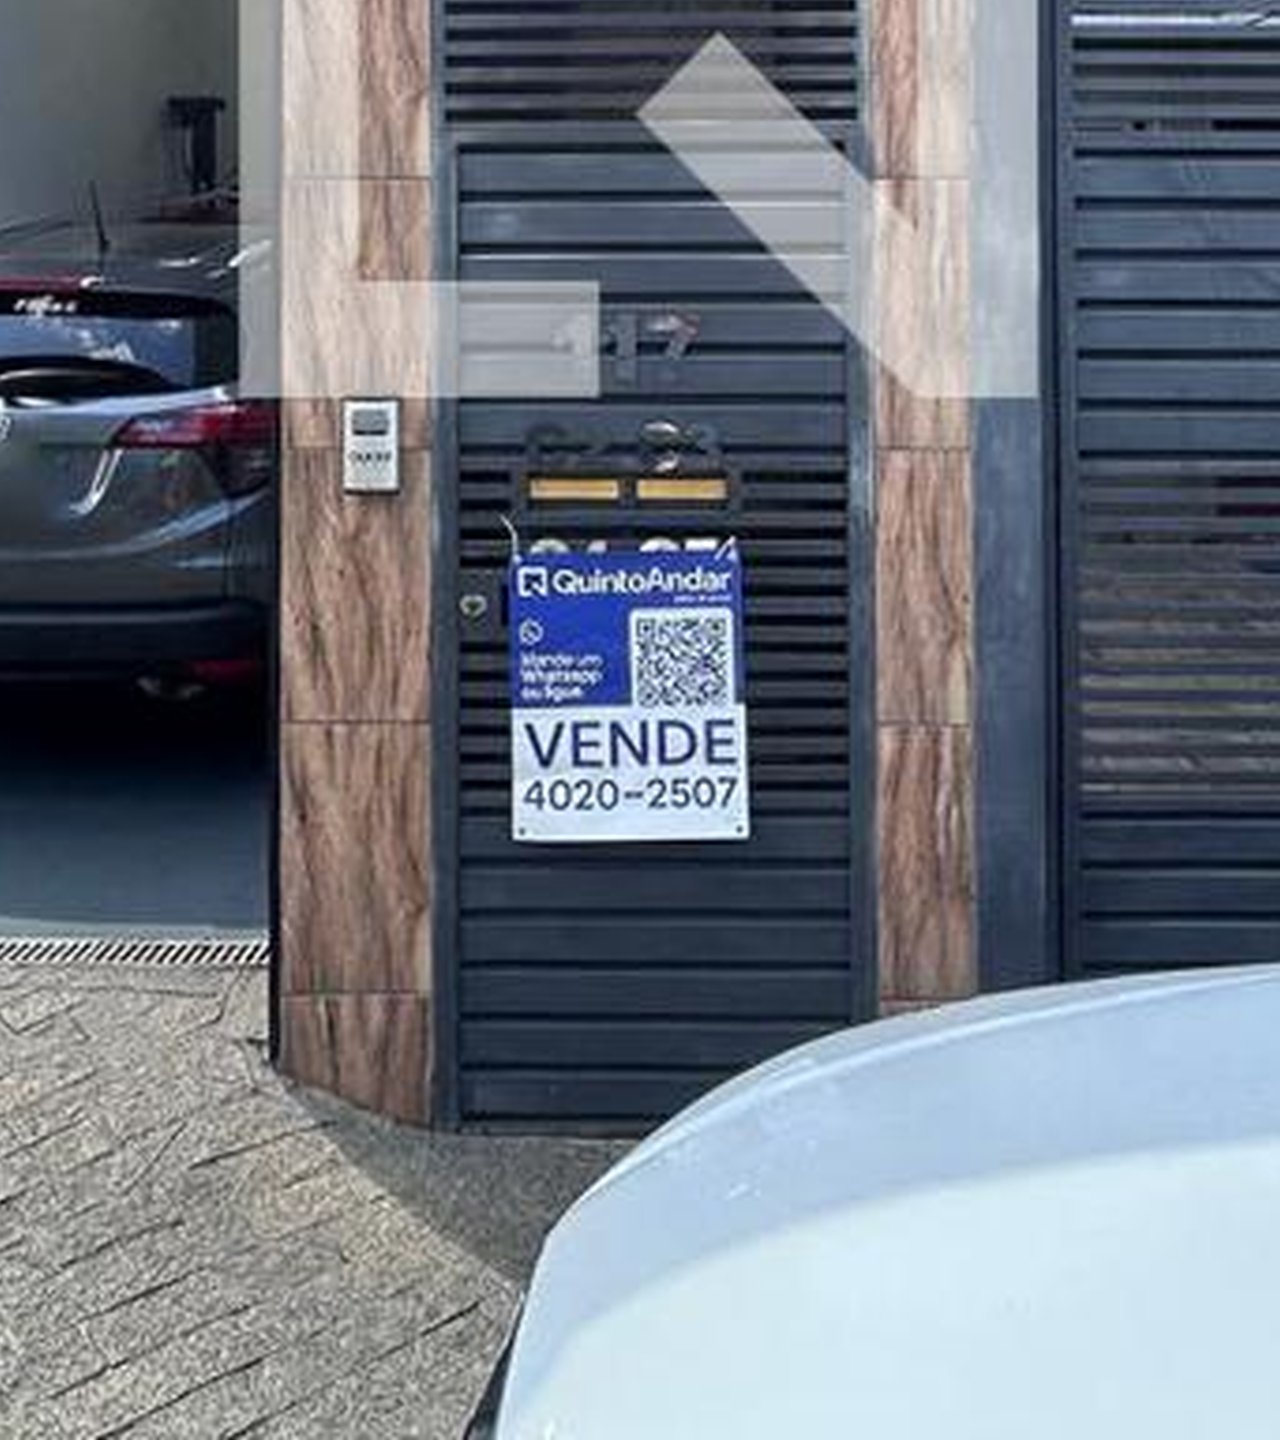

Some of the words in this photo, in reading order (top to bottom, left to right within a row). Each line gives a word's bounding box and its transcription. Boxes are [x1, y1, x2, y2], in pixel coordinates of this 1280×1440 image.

[552, 567, 732, 594] QuintoAndar
[524, 718, 738, 769] VENDE
[523, 777, 739, 811] 4020-2507
